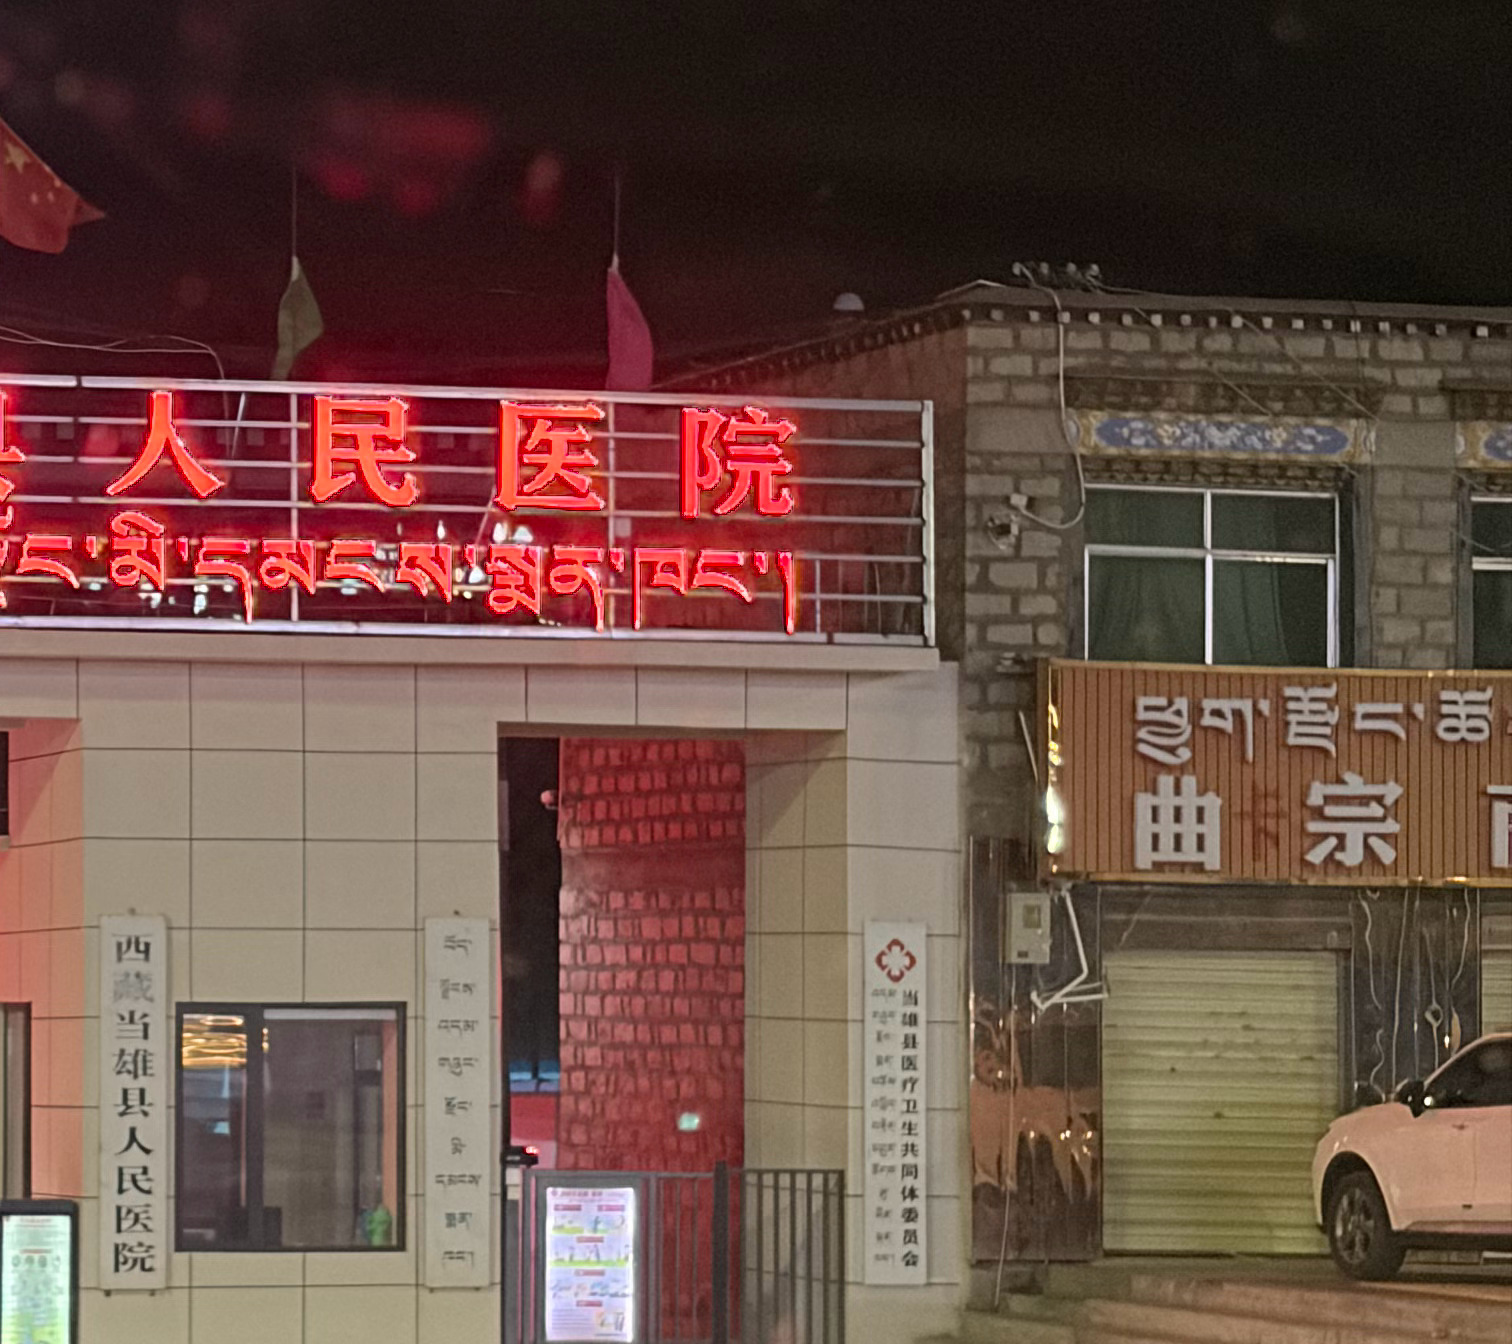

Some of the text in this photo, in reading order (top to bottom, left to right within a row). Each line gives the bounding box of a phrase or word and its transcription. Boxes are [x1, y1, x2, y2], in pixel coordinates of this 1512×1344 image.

[1134, 772, 1512, 870] 曲宗
[111, 933, 157, 1274] 西藏当雄县人民医院
